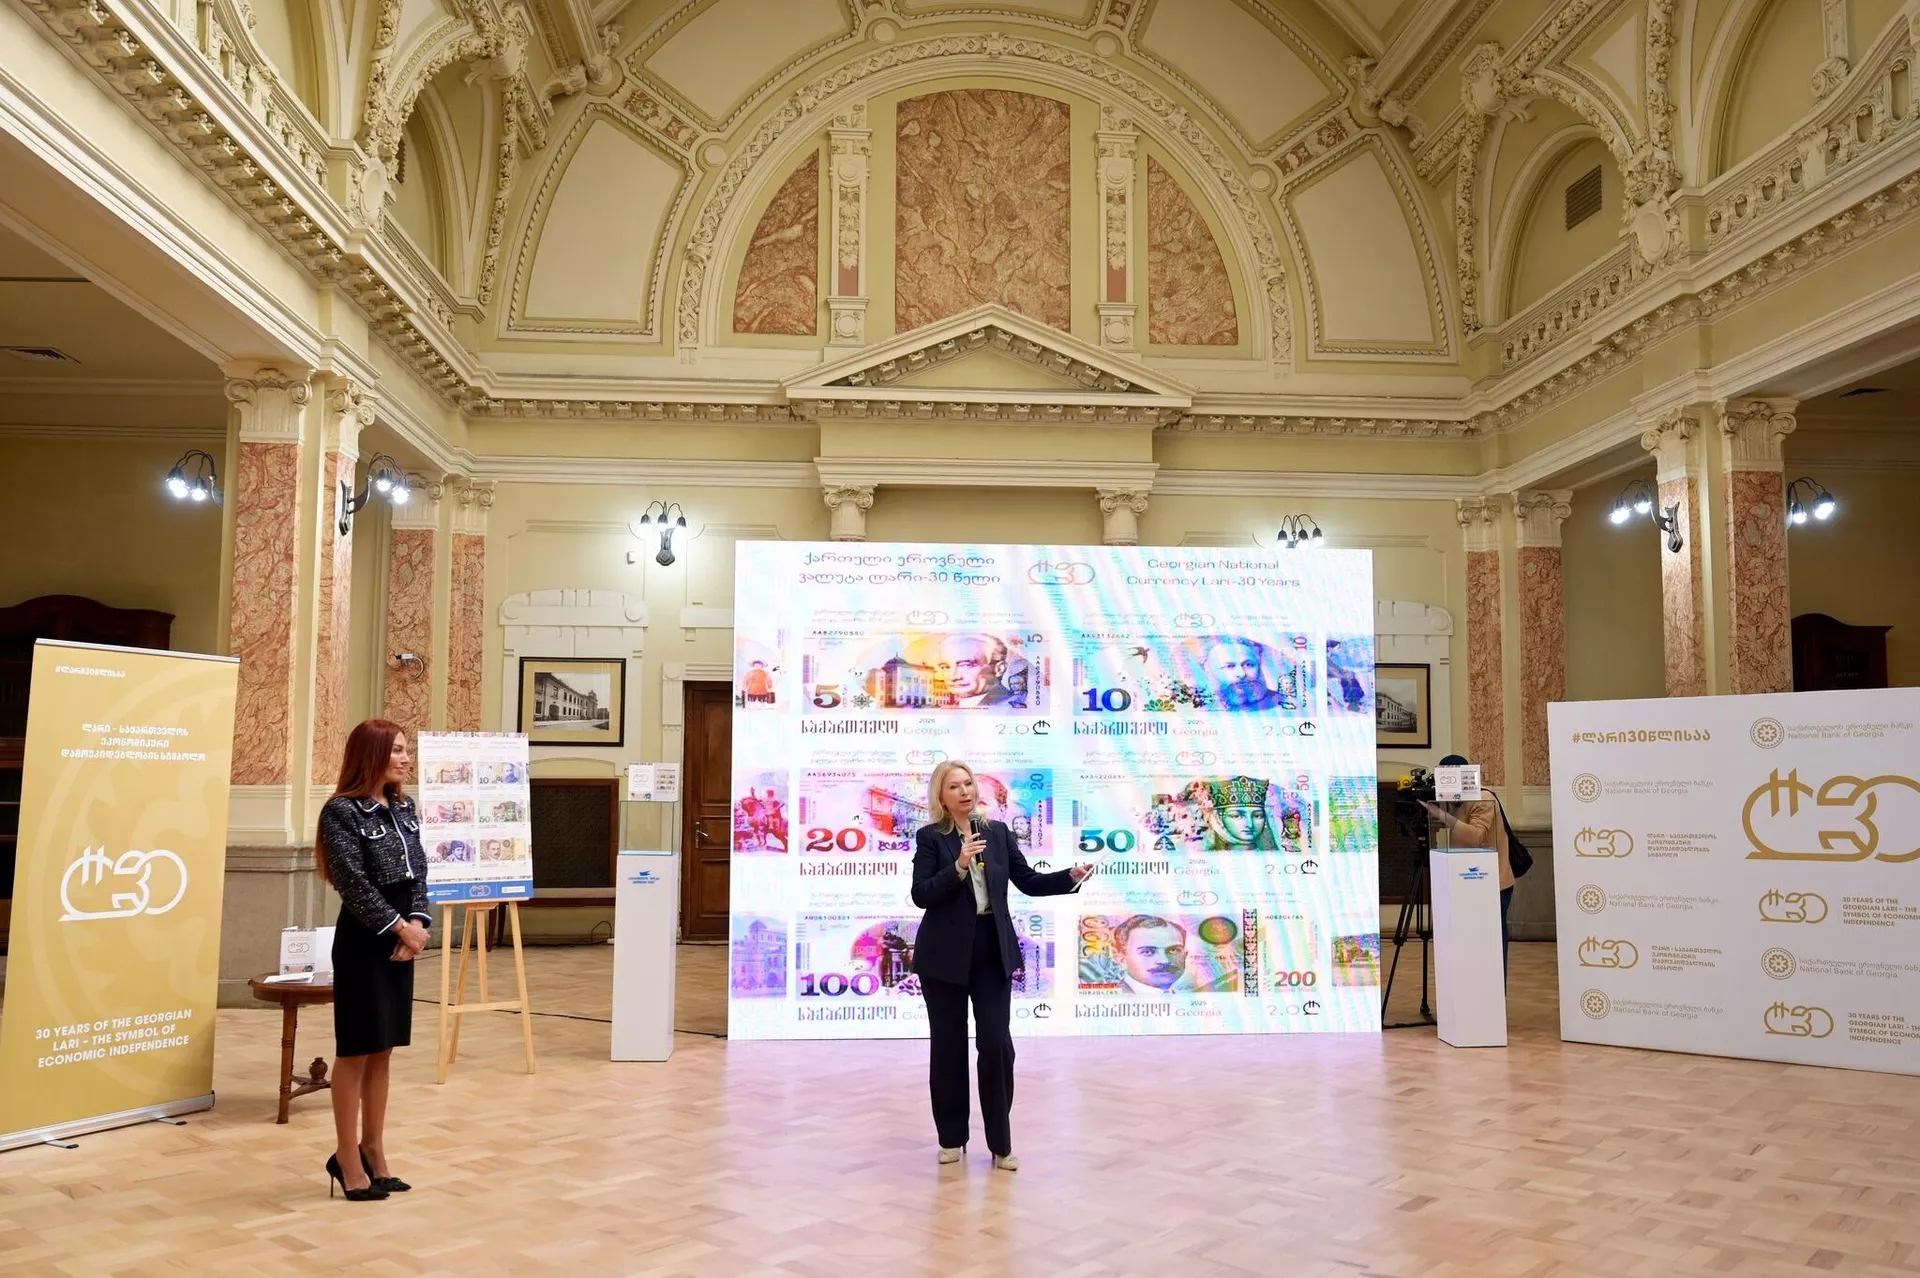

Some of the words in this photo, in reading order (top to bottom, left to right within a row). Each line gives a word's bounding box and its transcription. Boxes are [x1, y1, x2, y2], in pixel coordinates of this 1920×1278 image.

[803, 552, 892, 566] ქართული
[898, 553, 995, 568] ეროვნული
[1147, 558, 1215, 571] Georgian
[1218, 559, 1279, 570] National
[799, 572, 863, 584] ვალუტა
[868, 571, 948, 585] ლარი-30
[953, 571, 1000, 586] წელი
[1126, 575, 1198, 587] Currency
[1257, 577, 1300, 587] Years
[813, 684, 842, 709] 5
[1082, 687, 1132, 712] 10
[82, 723, 111, 733] ლარი
[119, 725, 190, 737] საქართველოს
[903, 726, 950, 737] Georgia
[1173, 727, 1219, 737] Georgia
[1572, 729, 1711, 744] #ლარი30წლისაა
[1853, 731, 1884, 740] Georgia
[100, 737, 170, 749] ეკონომიკური
[160, 753, 206, 762] სიმბოლო
[1030, 773, 1044, 790] 20
[1661, 787, 1689, 795] Georgia
[425, 816, 439, 824] 20
[806, 827, 866, 852] 20
[1078, 829, 1136, 853] 50
[1174, 866, 1220, 877] Georgia
[1666, 903, 1693, 911] Georgia
[1843, 911, 1870, 919] SYMBOL
[1029, 914, 1043, 938] 100
[1843, 919, 1895, 927] INDEPENDENCE
[1274, 970, 1317, 987] 200
[1800, 966, 1832, 974] National
[1834, 967, 1853, 975] Bank
[1866, 969, 1898, 979] Georgia
[800, 972, 879, 996] 100
[1175, 1008, 1222, 1018] Georgia
[1613, 1006, 1641, 1014] National
[1671, 1011, 1698, 1020] Georgia
[35, 1028, 51, 1040] 30
[54, 1022, 91, 1038] YEARS
[93, 1019, 110, 1032] OF
[112, 1016, 132, 1029] THE
[134, 1009, 192, 1026] GEORGIAN
[1848, 1020, 1887, 1028] GEORGIAN
[1848, 1027, 1877, 1035] SYMBOL
[52, 1037, 79, 1052] LARI
[92, 1033, 112, 1046] THE
[115, 1026, 159, 1042] SYMBOL
[161, 1024, 177, 1035] OF
[1849, 1035, 1902, 1045] INDEPENDENCE
[38, 1048, 106, 1068] ECONOMIC
[109, 1035, 190, 1057] INDEPENDENCE
